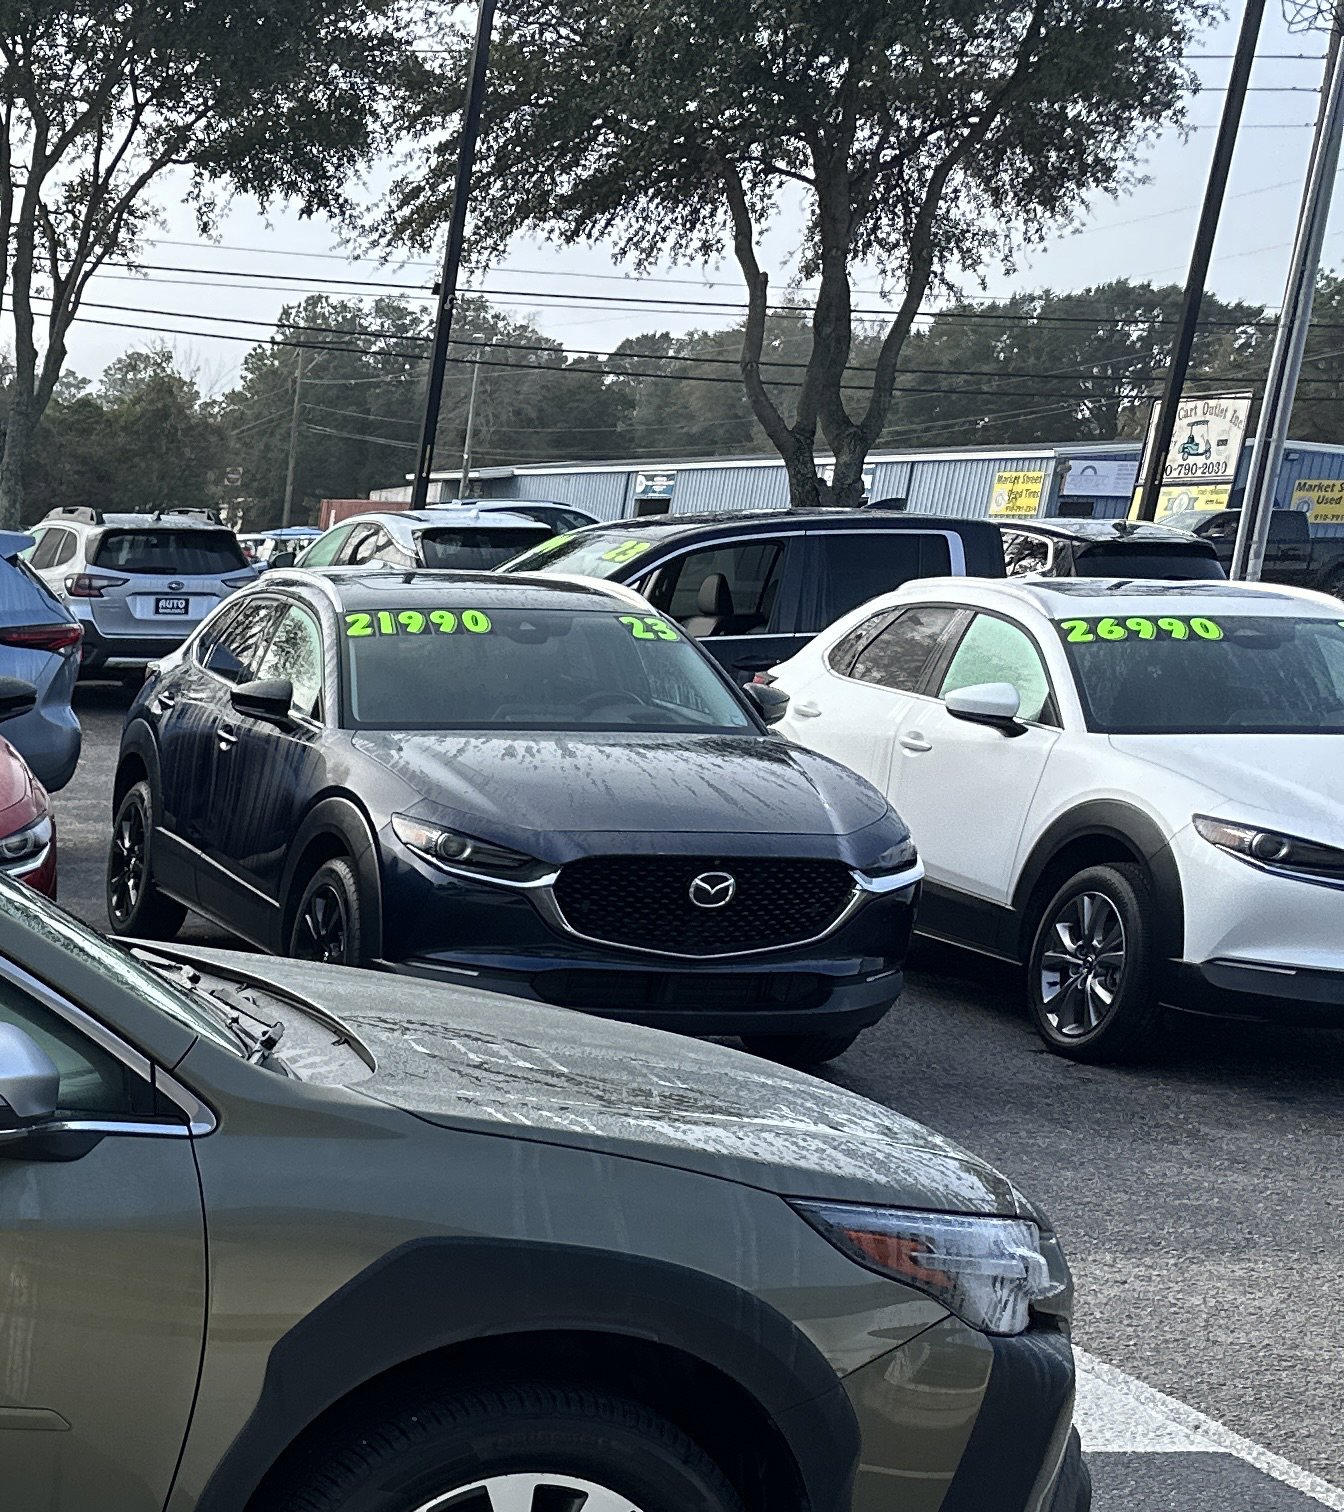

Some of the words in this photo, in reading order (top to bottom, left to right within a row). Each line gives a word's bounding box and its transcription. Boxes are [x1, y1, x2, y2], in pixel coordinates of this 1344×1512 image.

[1178, 405, 1198, 420] Cart
[1203, 401, 1228, 420] Outlet
[1165, 461, 1228, 477] 0-790-2030
[1296, 482, 1336, 492] Market
[1316, 495, 1342, 505] Used
[158, 599, 185, 609] AUTO
[345, 609, 493, 637] 21990
[619, 615, 680, 642] 23
[1060, 617, 1224, 643] 26990
